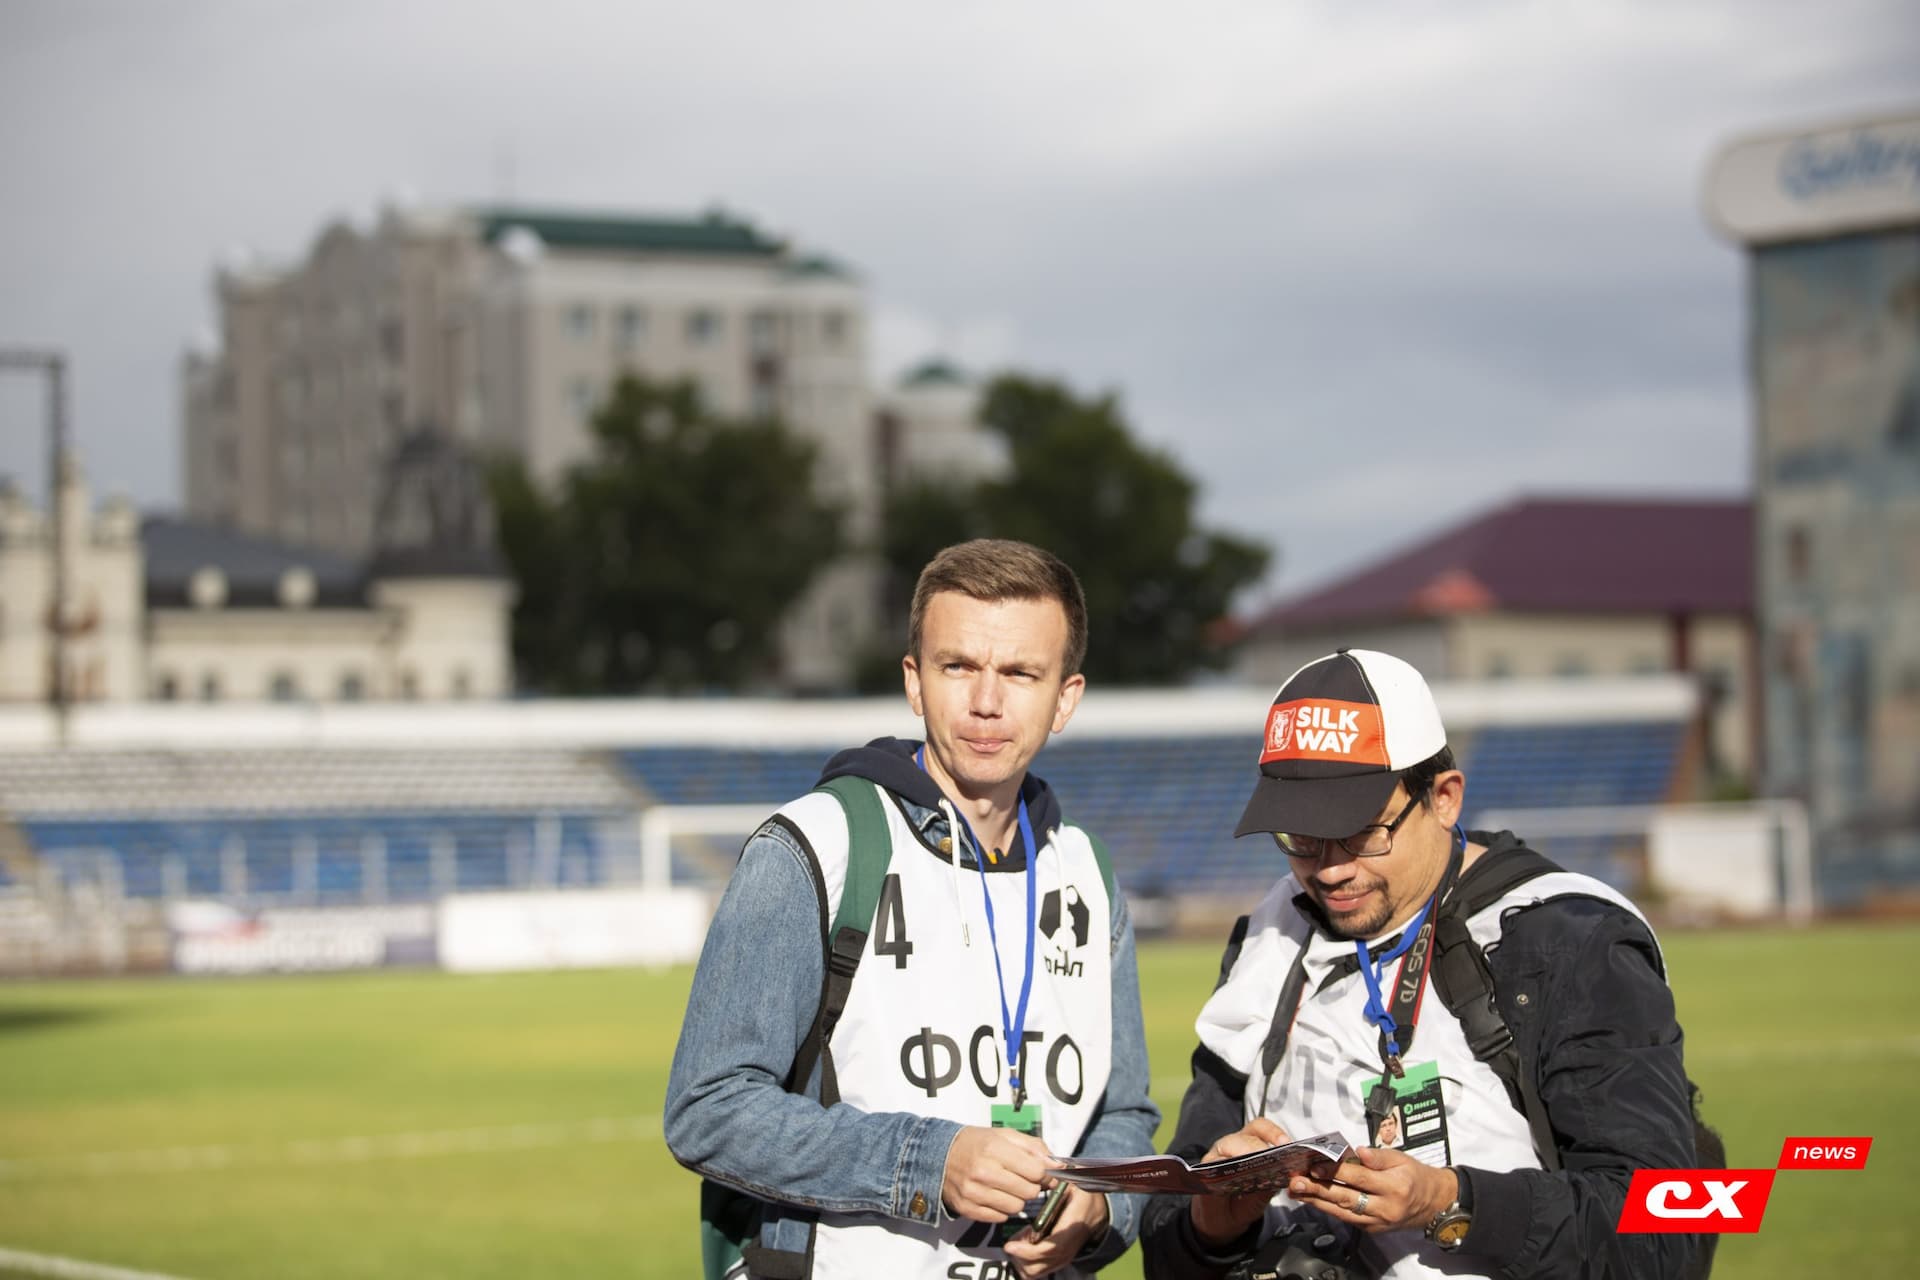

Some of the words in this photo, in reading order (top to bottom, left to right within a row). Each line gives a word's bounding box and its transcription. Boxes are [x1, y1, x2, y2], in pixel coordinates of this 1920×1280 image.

[1296, 706, 1360, 732] SILK
[1295, 729, 1359, 754] WAY
[874, 873, 913, 969] 4
[1408, 924, 1432, 973] EOS
[1399, 977, 1419, 1003] 7D
[900, 1024, 1084, 1105] ФОТО
